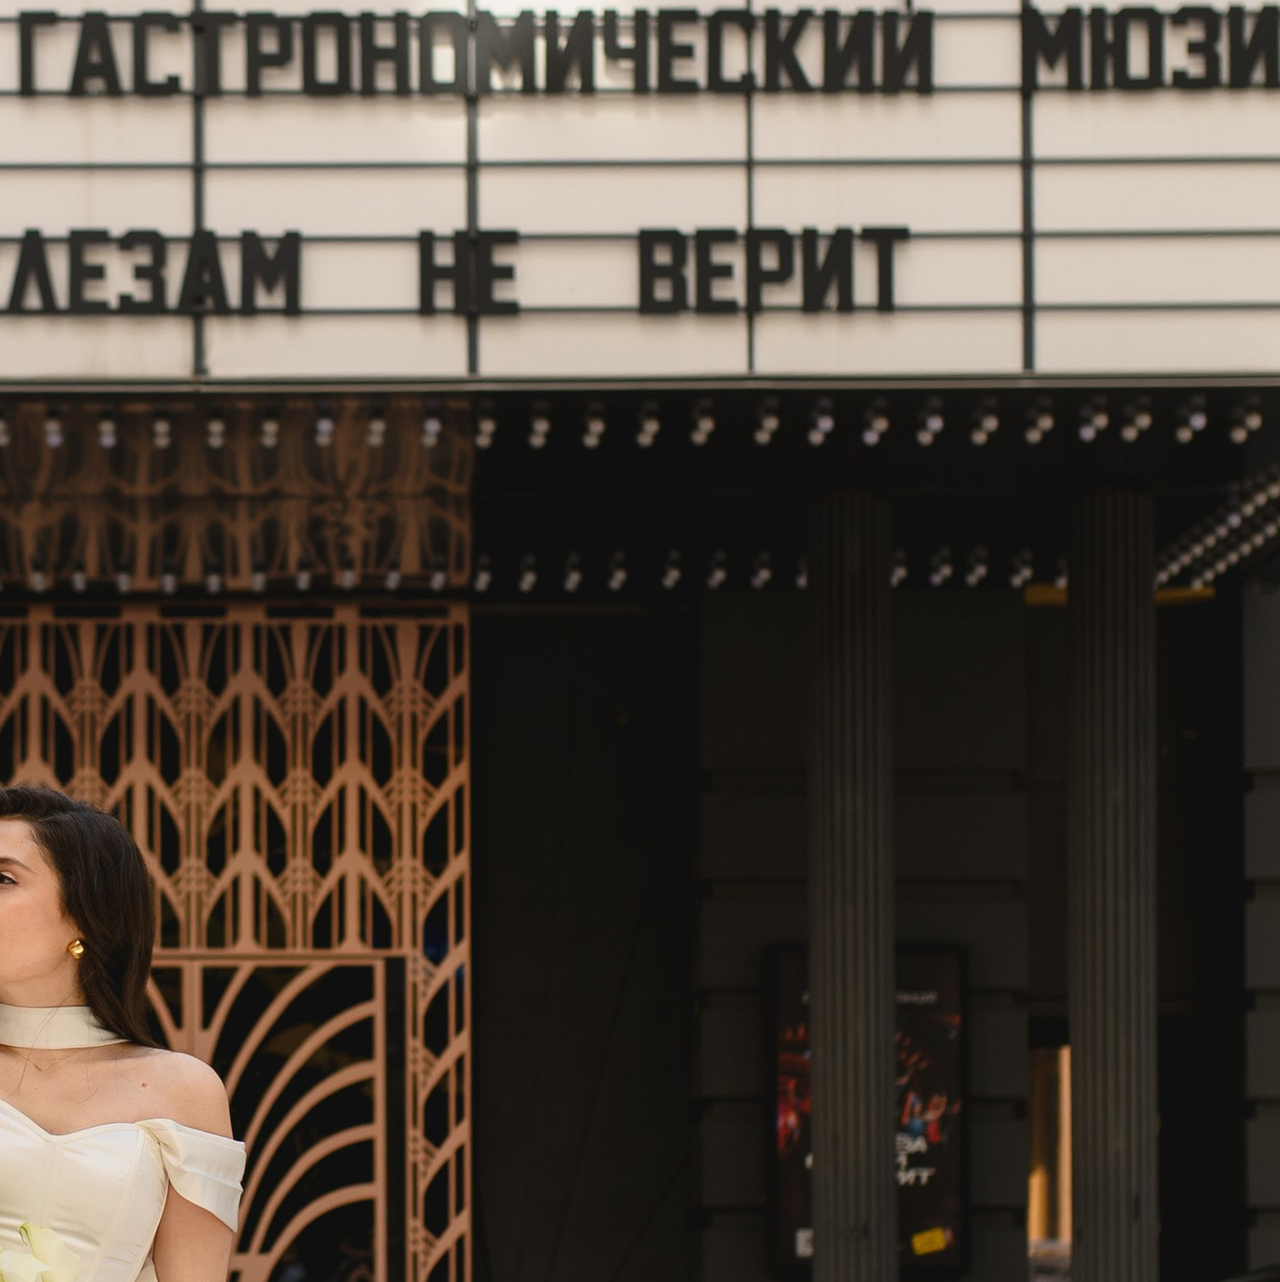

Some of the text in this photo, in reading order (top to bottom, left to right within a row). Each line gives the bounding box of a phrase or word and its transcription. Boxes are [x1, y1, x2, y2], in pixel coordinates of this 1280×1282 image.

[1022, 5, 1280, 89] МЮЗИ
[419, 228, 518, 316] НЕ
[639, 226, 909, 315] ВЕРИТ
